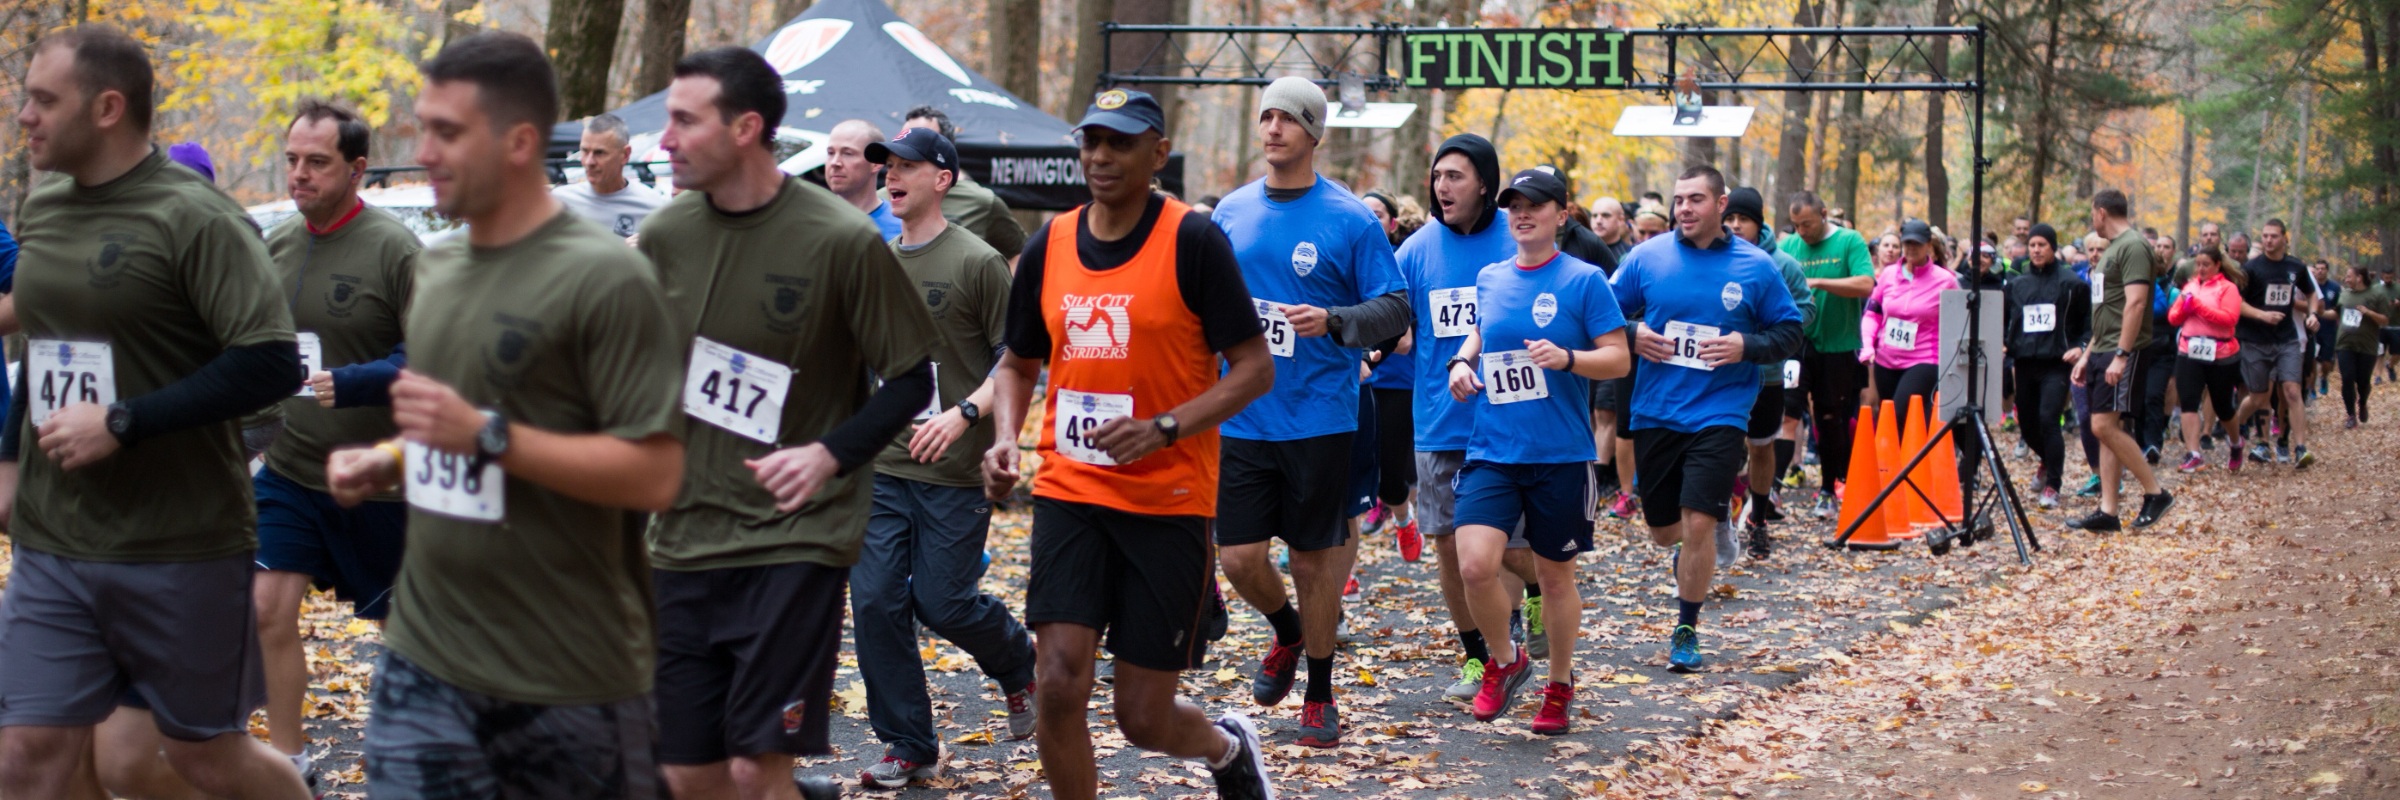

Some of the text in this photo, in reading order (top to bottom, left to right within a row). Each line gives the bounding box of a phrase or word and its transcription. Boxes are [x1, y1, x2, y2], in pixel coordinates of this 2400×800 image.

[1406, 32, 1625, 86] FINISH
[1439, 302, 1476, 327] 473
[2029, 313, 2051, 326] 342
[1260, 317, 1286, 346] 25
[1889, 328, 1910, 344] 494
[1062, 344, 1129, 361] STRIDERS
[41, 369, 99, 411] 476
[700, 369, 769, 419] 417
[1493, 366, 1536, 394] 160
[1066, 415, 1113, 450] 48
[417, 444, 482, 496] 398
